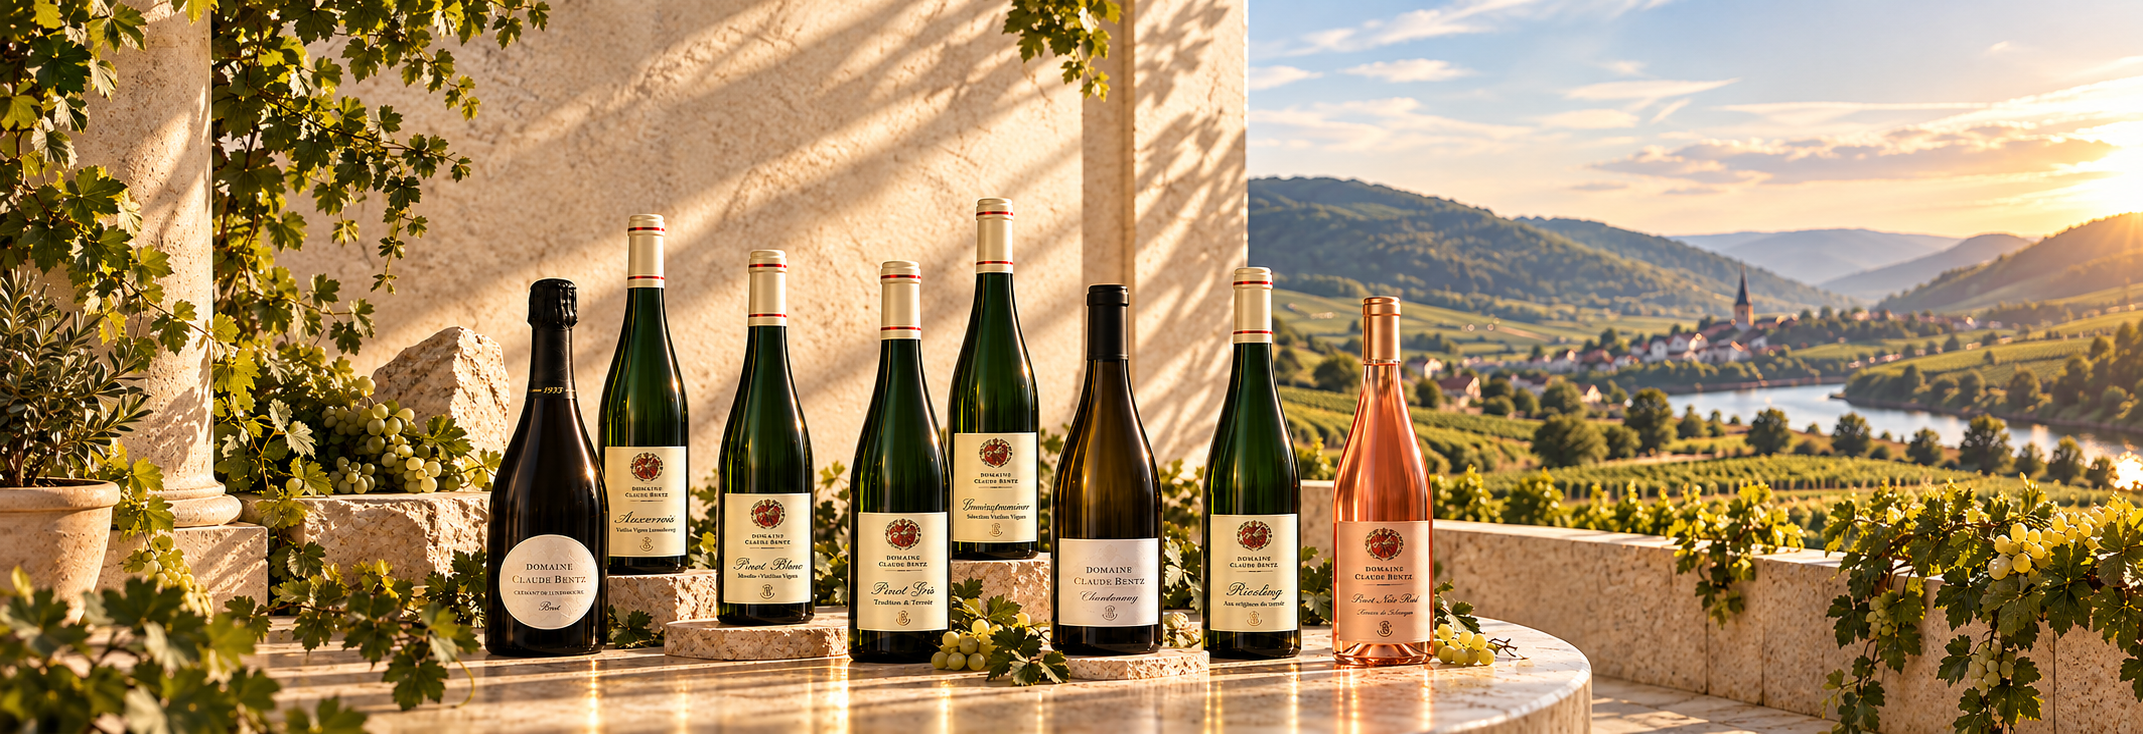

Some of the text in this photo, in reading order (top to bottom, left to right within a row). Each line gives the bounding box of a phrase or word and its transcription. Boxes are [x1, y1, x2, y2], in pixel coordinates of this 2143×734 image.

[614, 511, 675, 523] Auxerrois
[770, 558, 803, 570] Blanc
[512, 575, 586, 583] CLAUDE BENTZ
[1074, 577, 1145, 585] CLAUDE BENTZ
[871, 581, 935, 597] Pinot Gris
[1226, 582, 1283, 600] Riesling
[1080, 591, 1138, 604] Chardonnay
[539, 601, 560, 611] Brut
